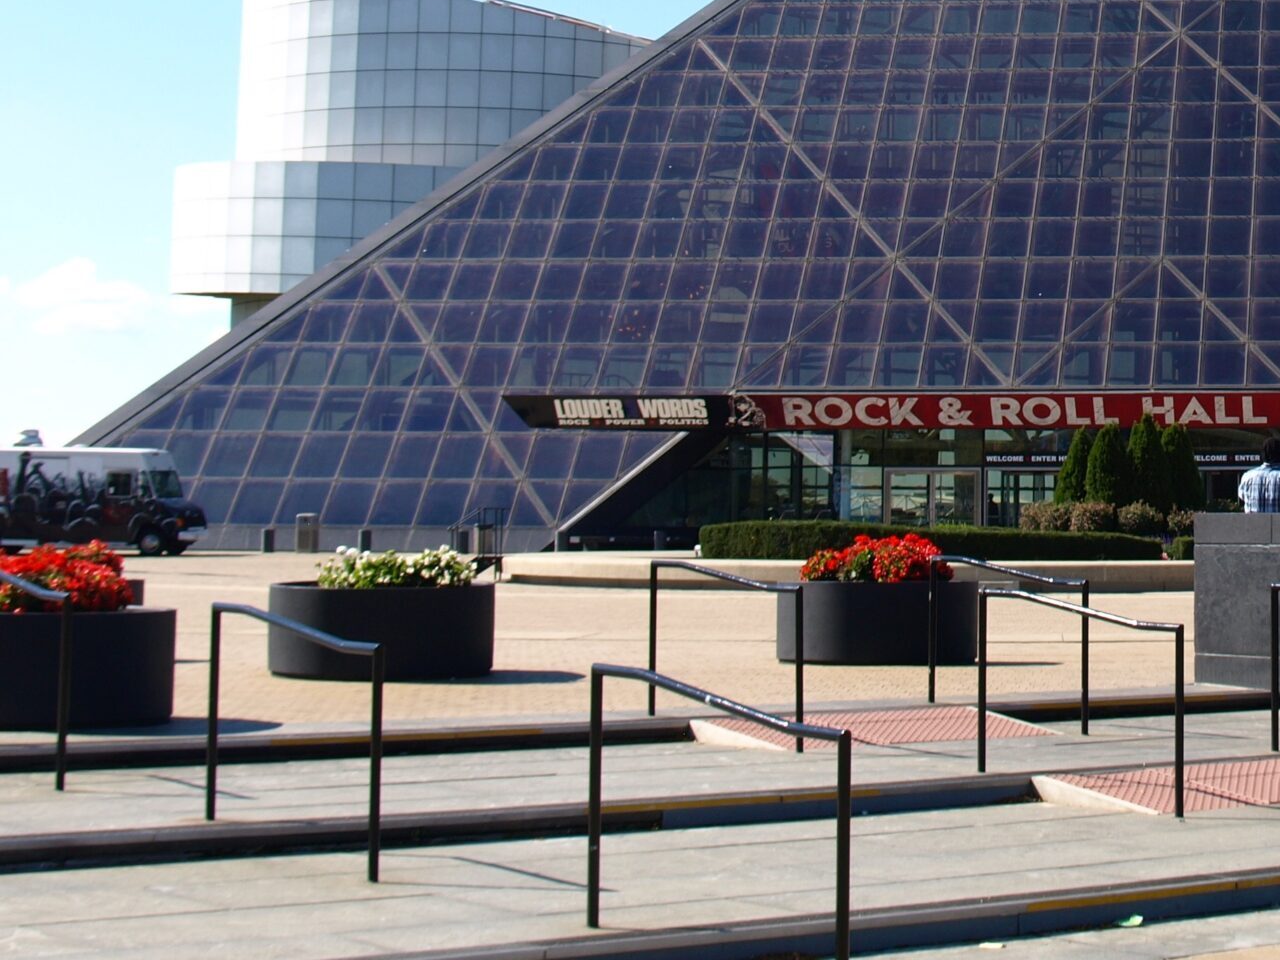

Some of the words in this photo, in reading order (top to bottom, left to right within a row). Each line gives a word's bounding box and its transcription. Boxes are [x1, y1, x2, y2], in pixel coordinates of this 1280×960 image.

[554, 399, 625, 419] LOUDER
[637, 399, 708, 419] WORDS
[782, 397, 924, 426] ROCK
[938, 397, 974, 426] &
[990, 396, 1120, 425] ROLL
[1141, 395, 1267, 424] HALL
